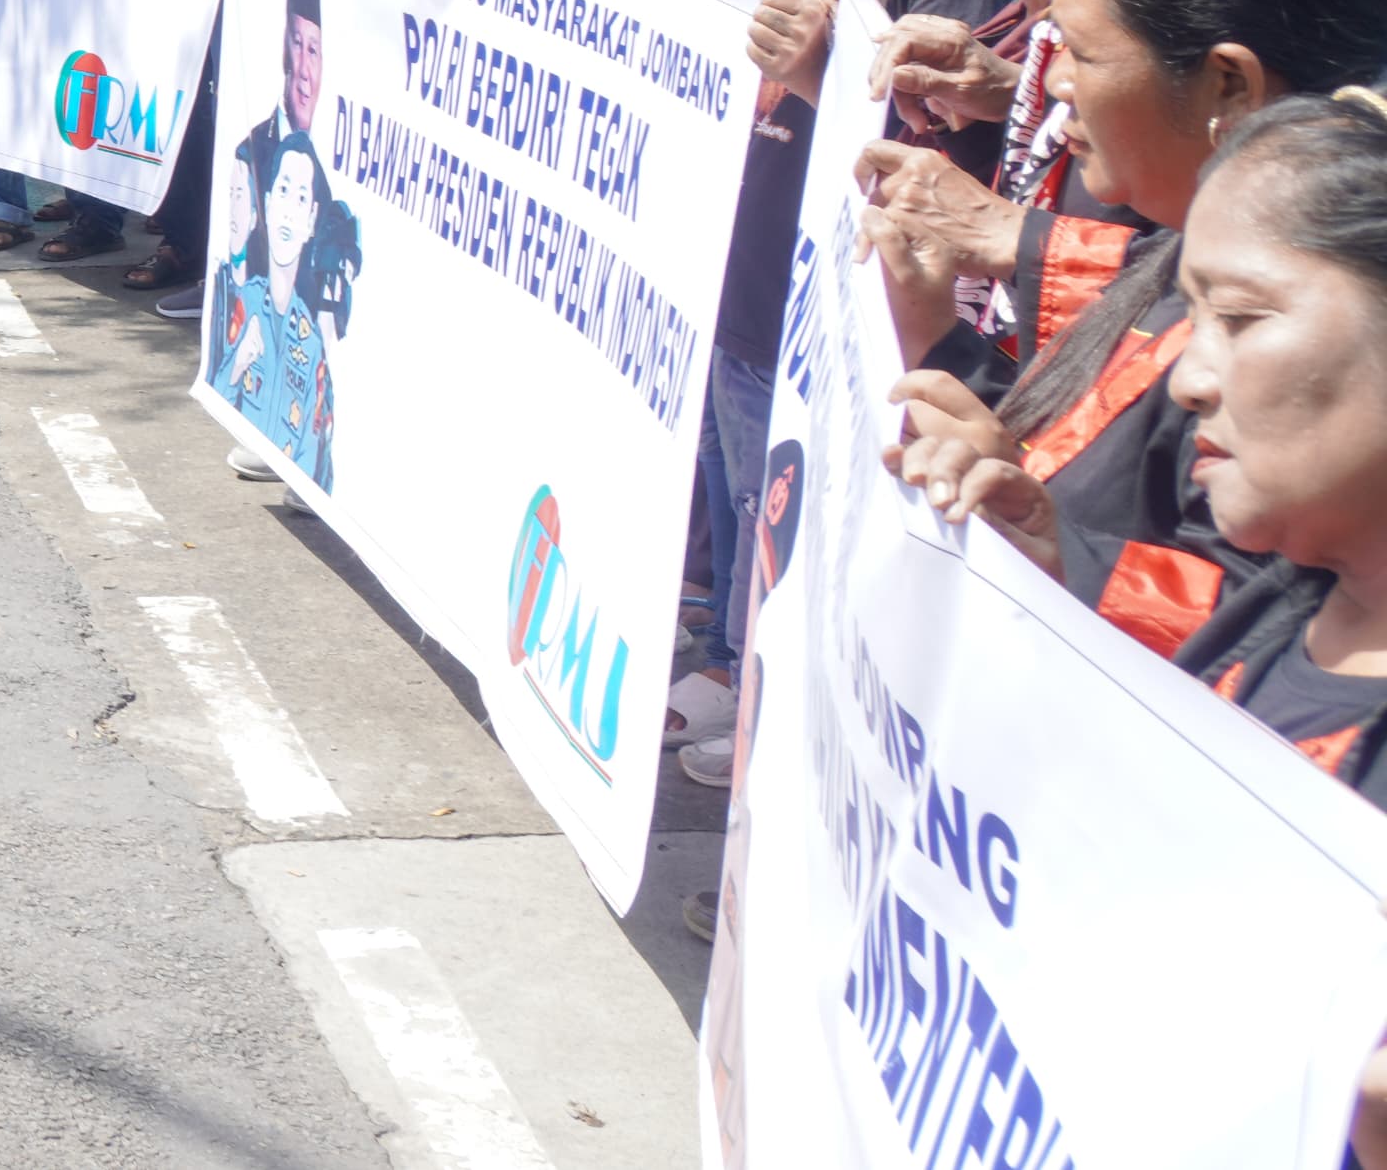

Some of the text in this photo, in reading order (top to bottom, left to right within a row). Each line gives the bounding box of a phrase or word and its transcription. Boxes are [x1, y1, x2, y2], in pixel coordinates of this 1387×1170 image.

[403, 12, 651, 223] POLRI BERDIRI TEGAK
[640, 28, 732, 123] JOMBANG
[333, 95, 354, 177] DI
[355, 106, 427, 223] BAWAH
[425, 142, 520, 279] PRESIDEN
[515, 196, 618, 350] REPUBLIK
[605, 260, 698, 436] INDONESIA
[851, 613, 1020, 930] JOMBNG
